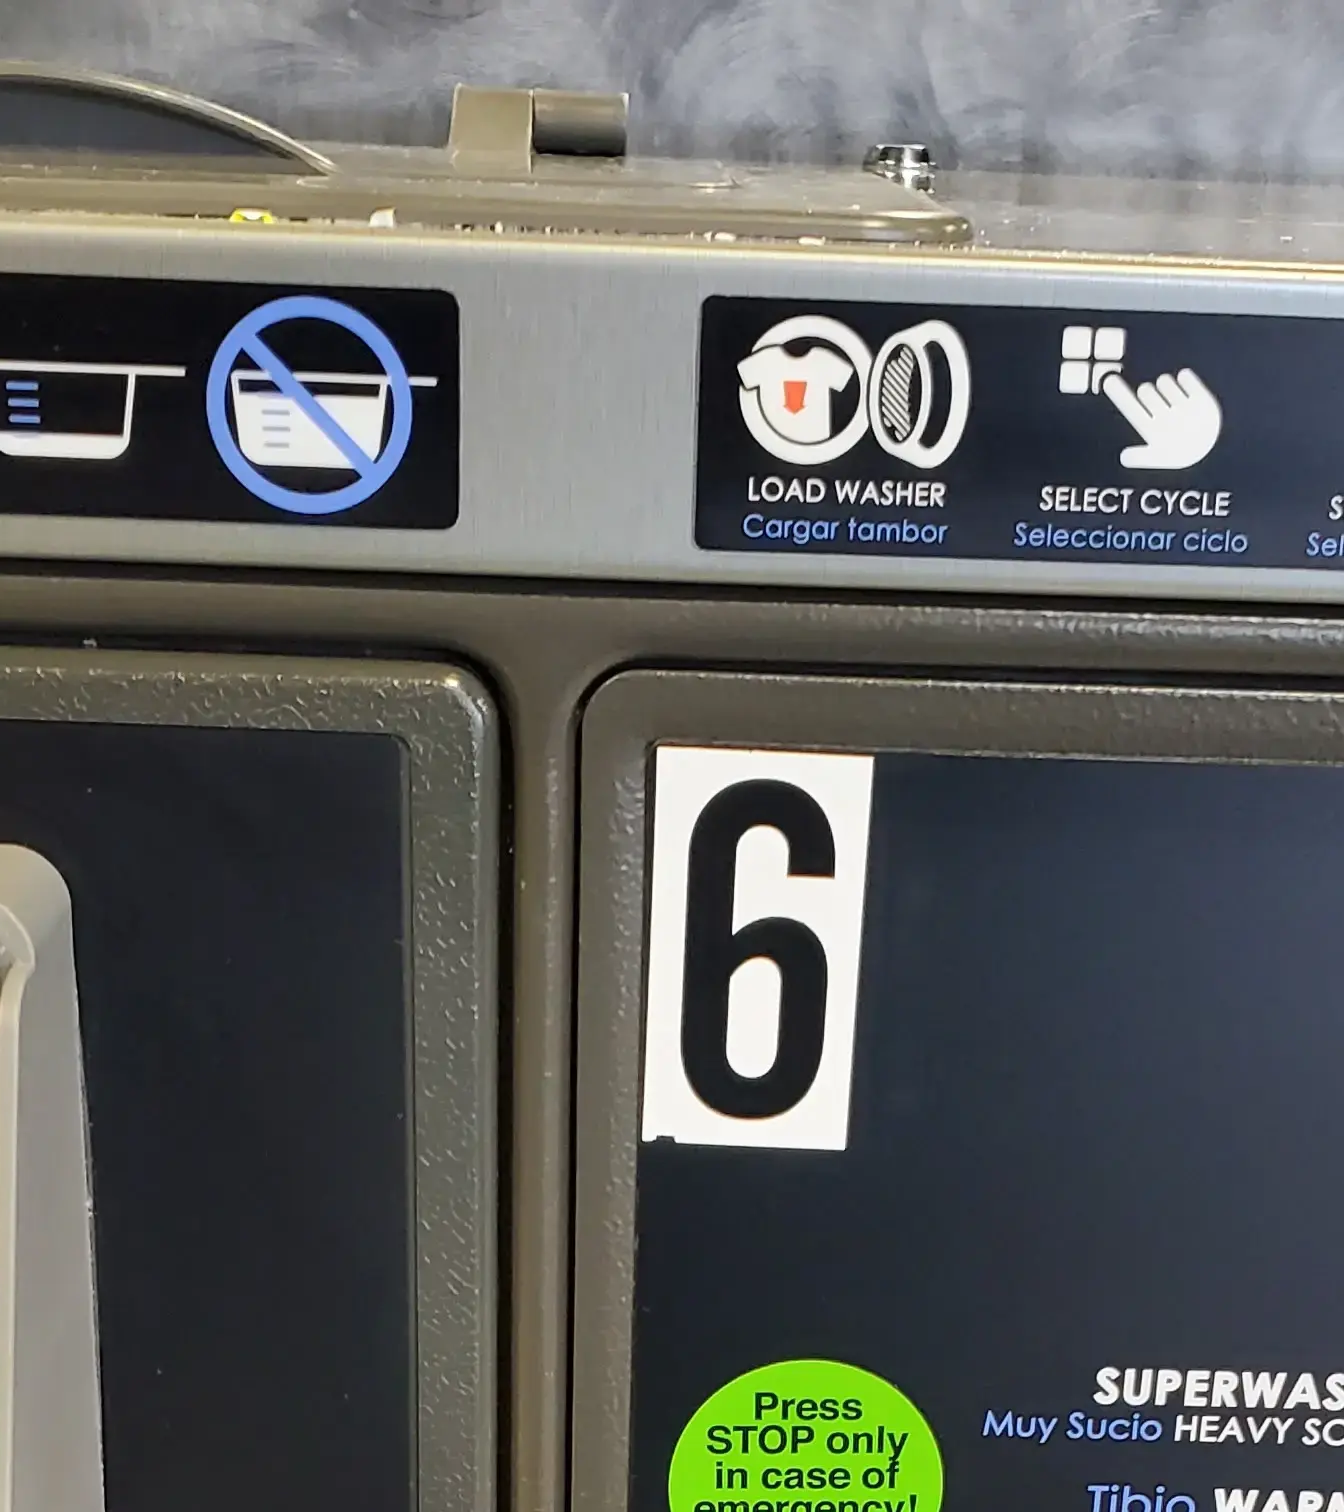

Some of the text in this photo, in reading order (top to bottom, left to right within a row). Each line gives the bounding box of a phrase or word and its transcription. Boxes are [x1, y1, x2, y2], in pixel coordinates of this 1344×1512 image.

[747, 477, 946, 508] LOAD WASHER
[1040, 486, 1232, 517] SELECT CYCLE
[743, 514, 948, 544] Cargar tambor
[1014, 522, 1249, 553] Seleccionar ciclo
[681, 778, 836, 1120] 6
[754, 1392, 863, 1420] Press
[706, 1425, 908, 1460] STOP only
[982, 1410, 1058, 1443] Muy
[1065, 1411, 1162, 1442] Sucio
[1173, 1415, 1294, 1445] HEAVY
[715, 1460, 899, 1489] in case of
